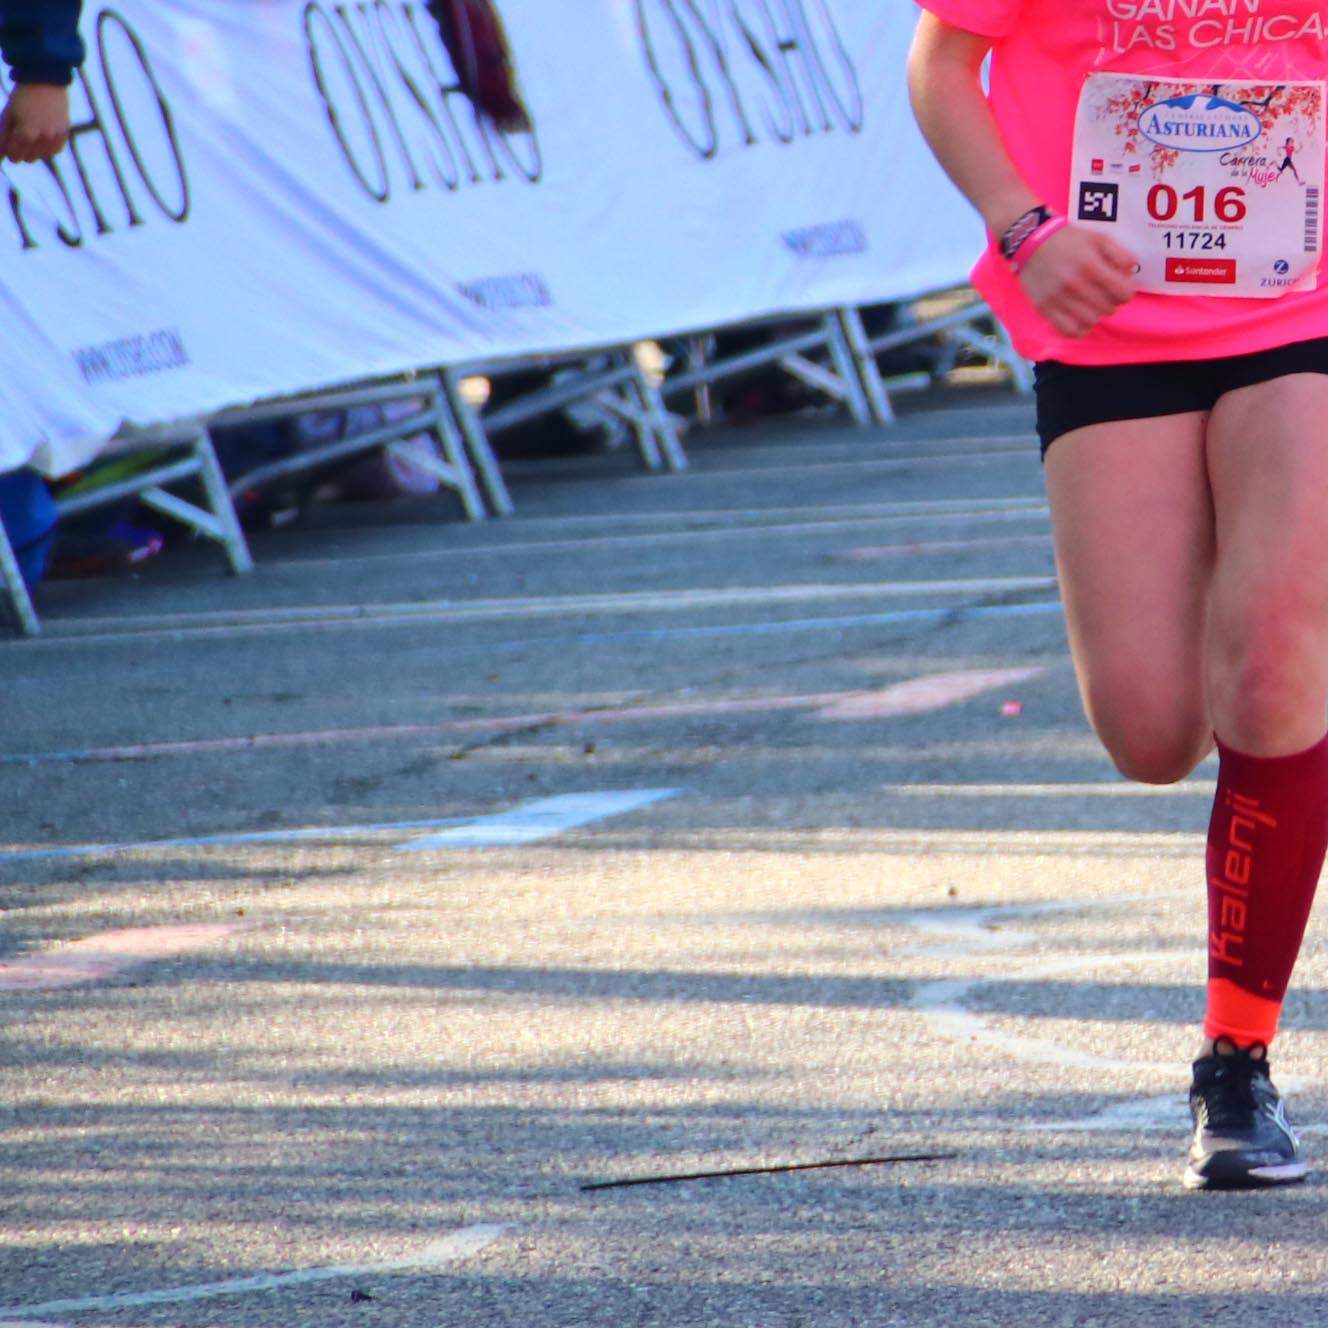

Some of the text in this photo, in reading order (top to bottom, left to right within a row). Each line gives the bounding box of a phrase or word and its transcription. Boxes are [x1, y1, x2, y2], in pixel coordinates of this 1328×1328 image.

[1112, 20, 1177, 53] LAS
[1147, 113, 1251, 138] ASTURIANA
[1219, 152, 1267, 167] Carrera
[1248, 168, 1282, 188] Mujer
[1147, 183, 1247, 222] 016
[1163, 231, 1227, 251] 11724
[1184, 266, 1228, 277] Santander
